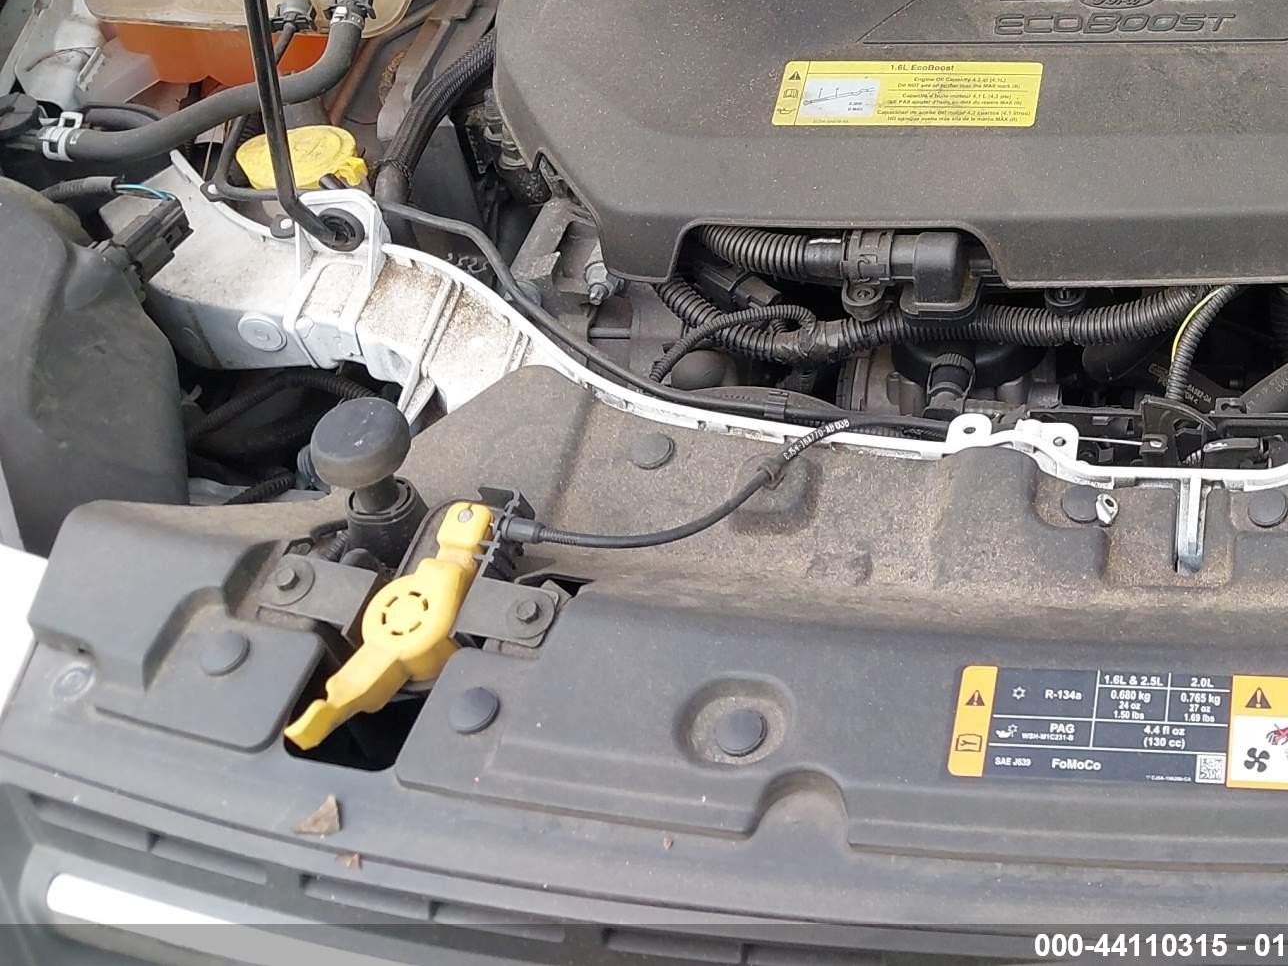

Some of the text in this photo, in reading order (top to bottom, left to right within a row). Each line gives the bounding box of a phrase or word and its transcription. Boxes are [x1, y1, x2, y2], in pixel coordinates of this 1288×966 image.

[1104, 675, 1164, 686] 1.6L & 2.5L
[1190, 677, 1214, 688] 2.0L
[1044, 689, 1083, 701] R-134a
[1110, 689, 1152, 703] 0.680 kg
[1180, 692, 1221, 706] 0.765 kg
[1118, 701, 1141, 710] 24 oz
[1200, 705, 1211, 713] oz
[1113, 710, 1145, 720] 1.50 lbs
[1202, 714, 1215, 723] lbs
[1049, 722, 1076, 734] PAG
[1143, 725, 1186, 736] 4.4 fl oz
[1143, 737, 1186, 749] (130 cc)
[994, 756, 1012, 766] SAE
[1051, 758, 1102, 770] FoMoCo
